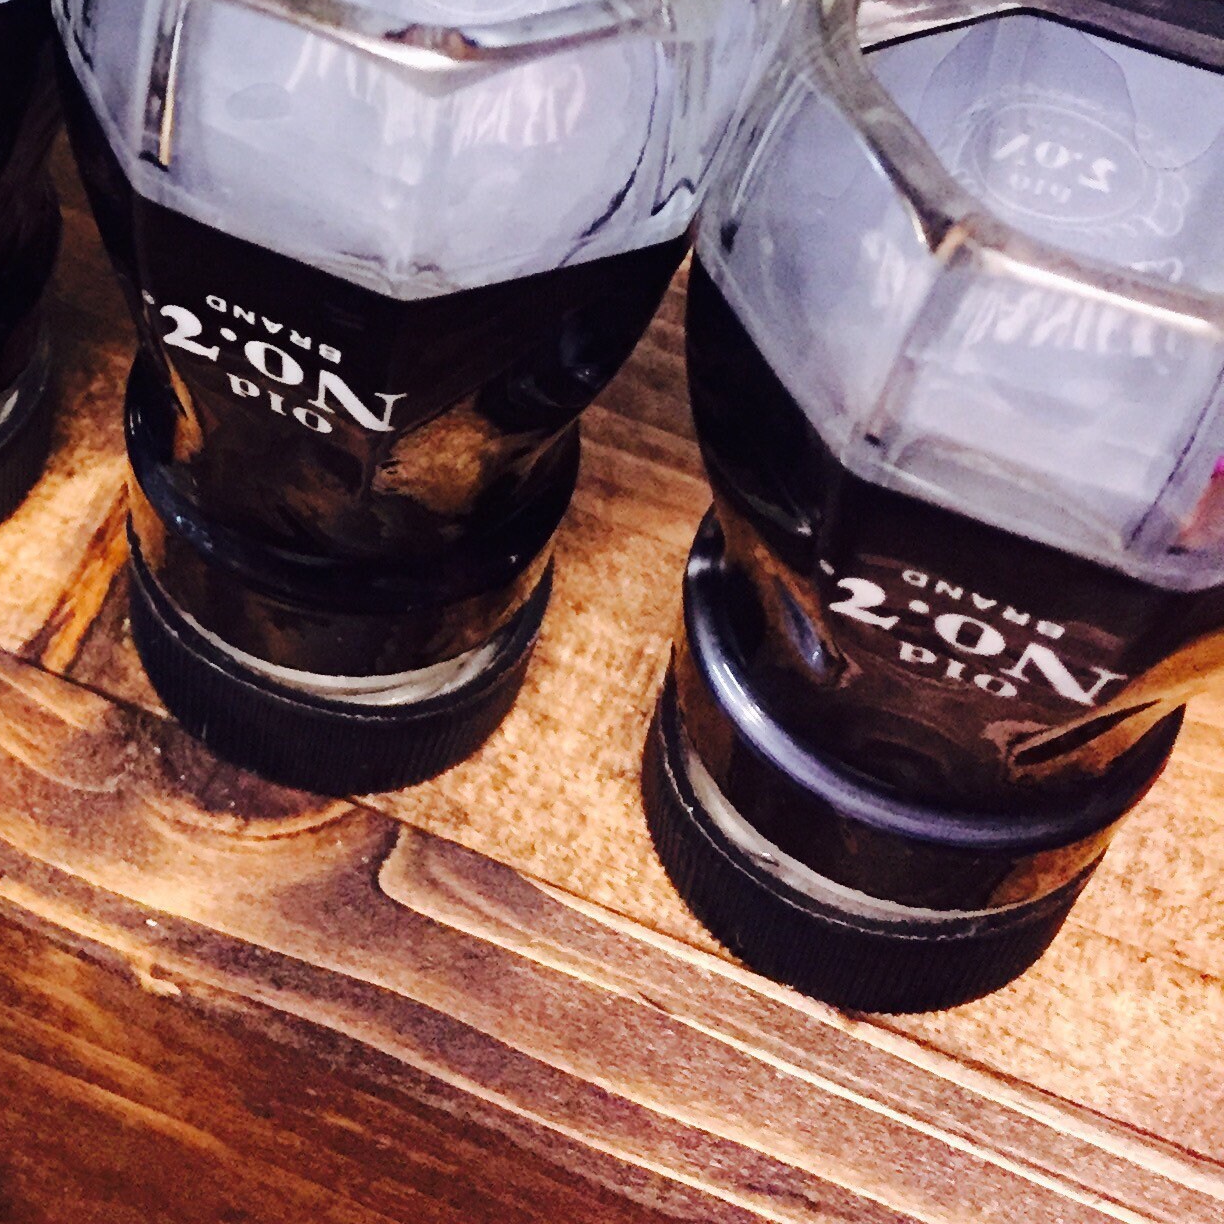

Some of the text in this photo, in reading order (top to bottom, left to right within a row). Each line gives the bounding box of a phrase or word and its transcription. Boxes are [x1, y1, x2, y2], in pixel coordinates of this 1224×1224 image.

[205, 294, 342, 365] BRAND
[226, 372, 333, 434] Old
[901, 569, 1066, 640] BRAND
[899, 641, 1018, 698] Old
